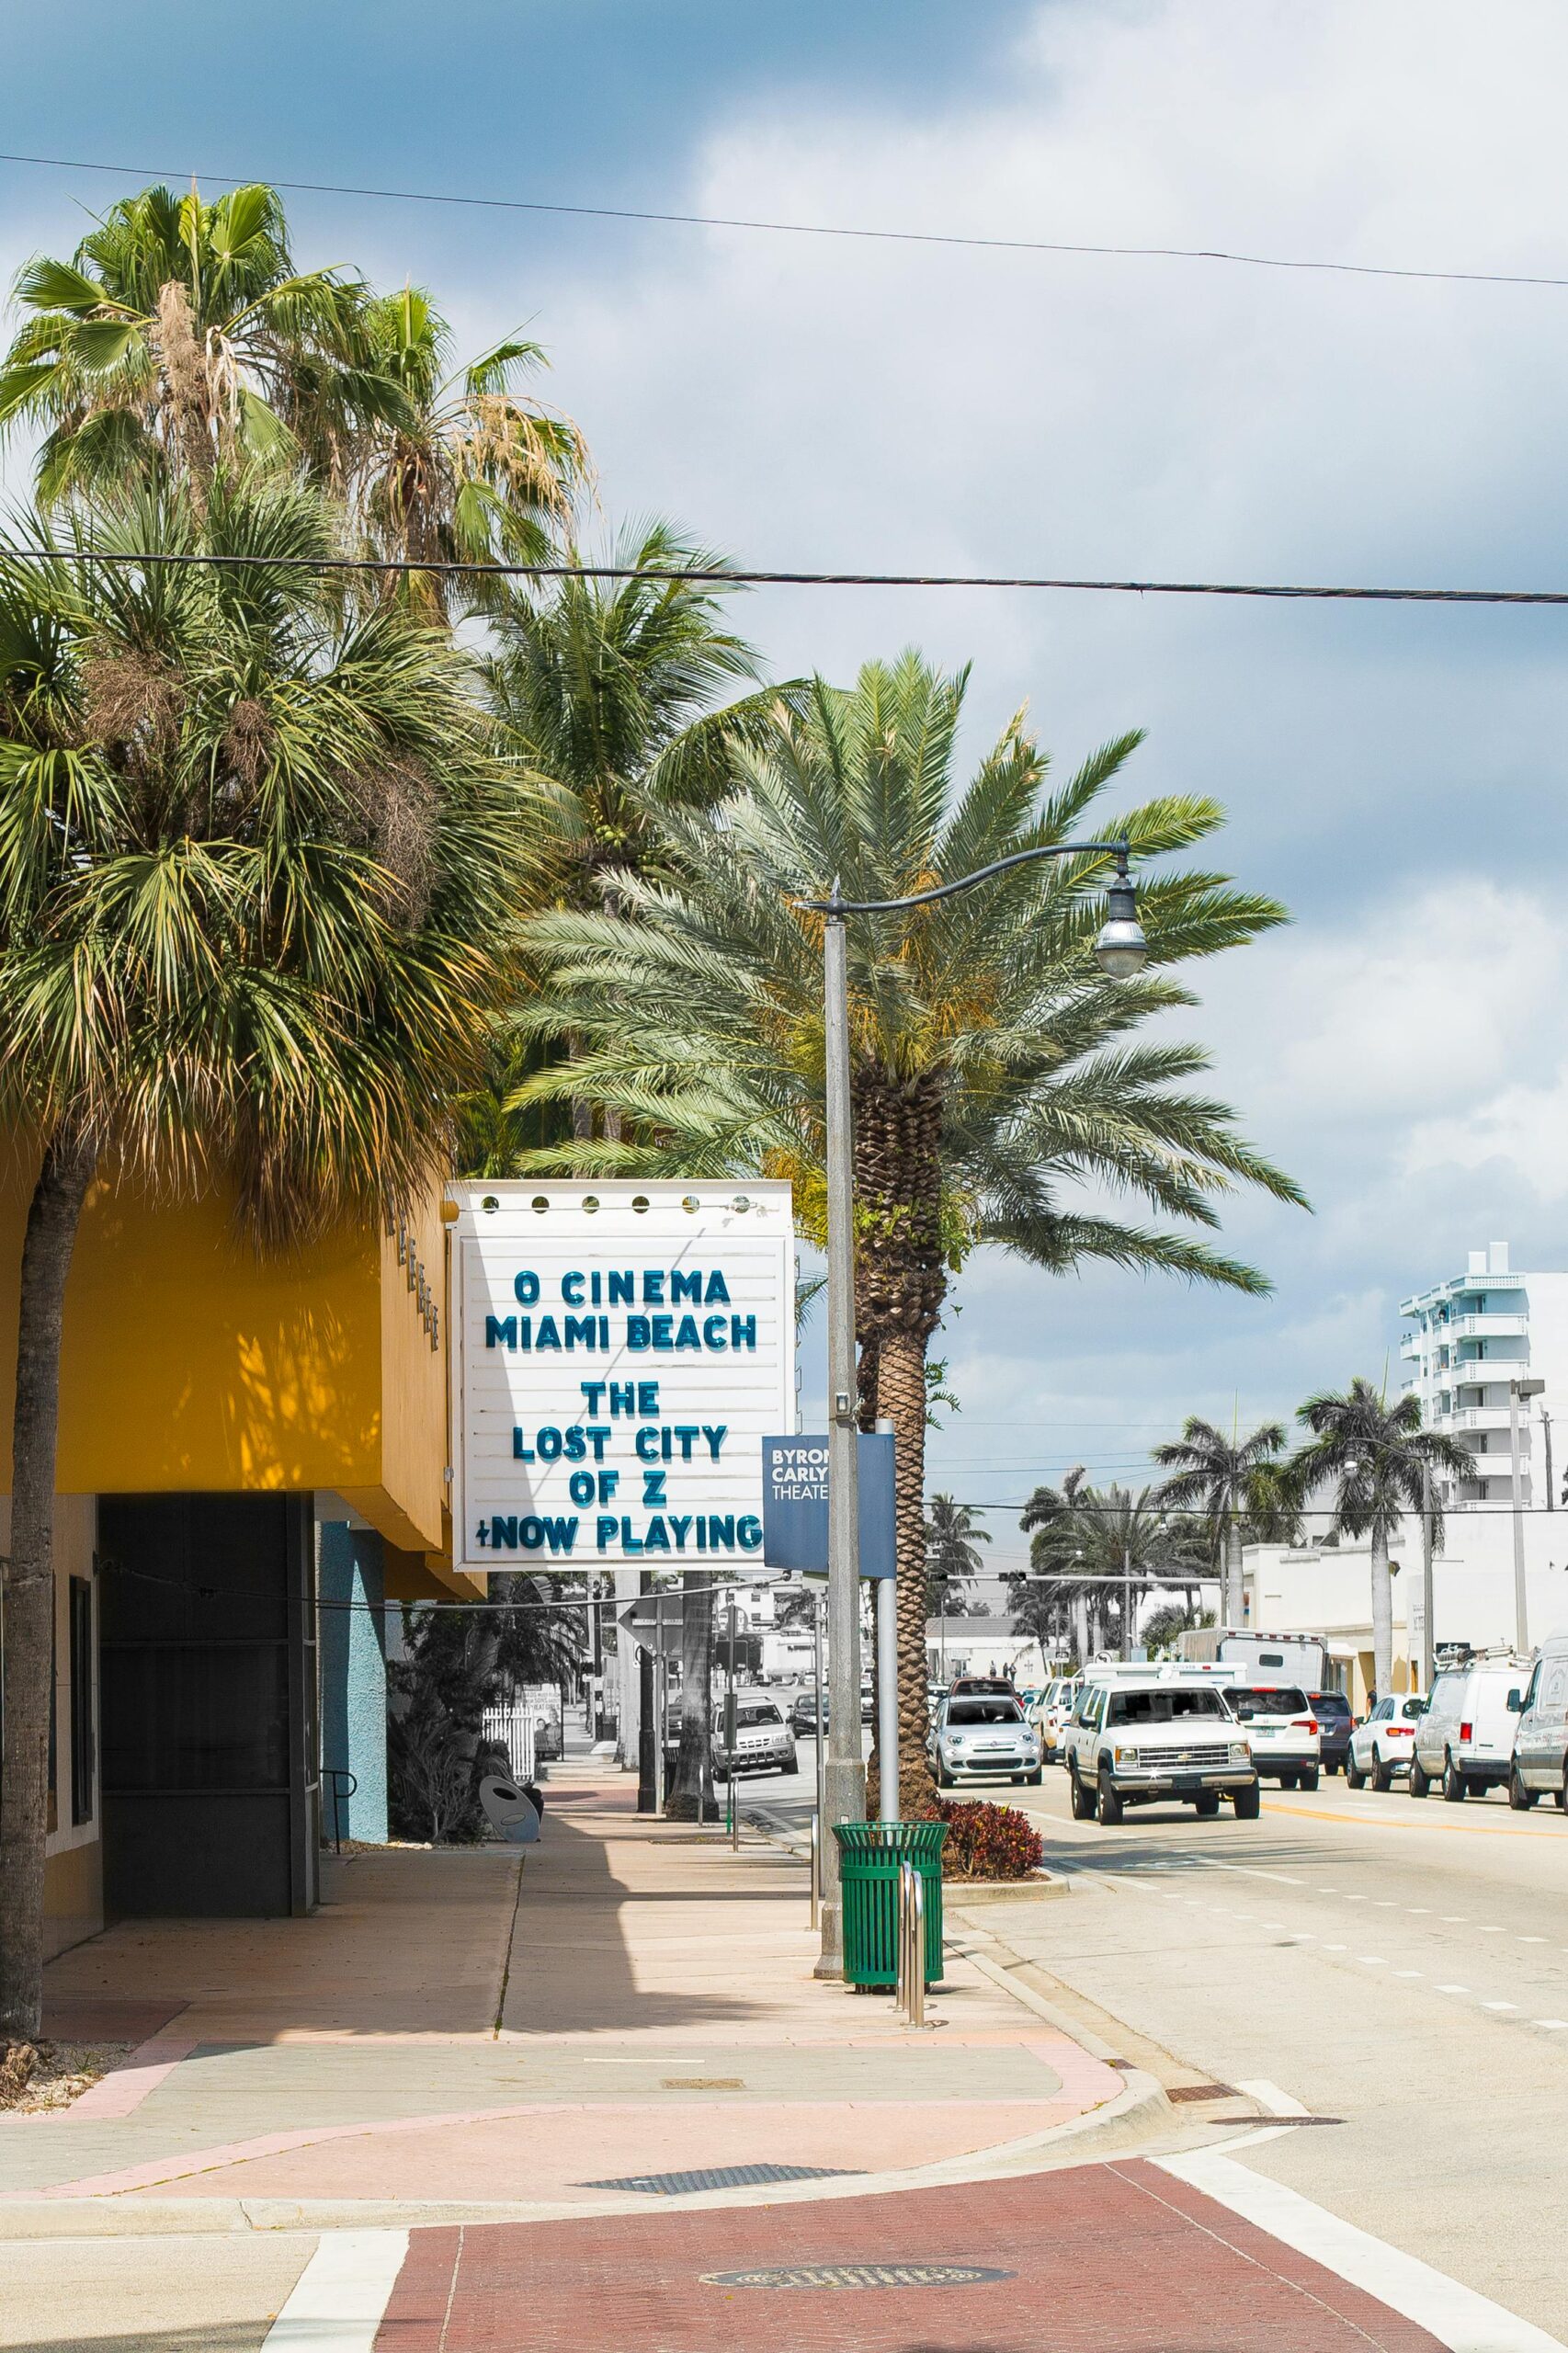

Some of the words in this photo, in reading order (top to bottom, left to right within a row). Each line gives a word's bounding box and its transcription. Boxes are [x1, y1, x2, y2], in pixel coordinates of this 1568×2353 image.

[514, 1270, 540, 1306] O
[561, 1269, 731, 1306] CINEMA
[485, 1314, 609, 1350] MIAMI
[626, 1313, 757, 1351] BEACH
[580, 1381, 660, 1416] THE
[513, 1426, 612, 1463] LOST
[635, 1425, 728, 1461] CITY
[569, 1470, 619, 1507] OF
[642, 1470, 667, 1506] Z
[771, 1484, 829, 1500] THEATE
[772, 1466, 829, 1483] CARLY
[597, 1515, 763, 1554] PLAYING
